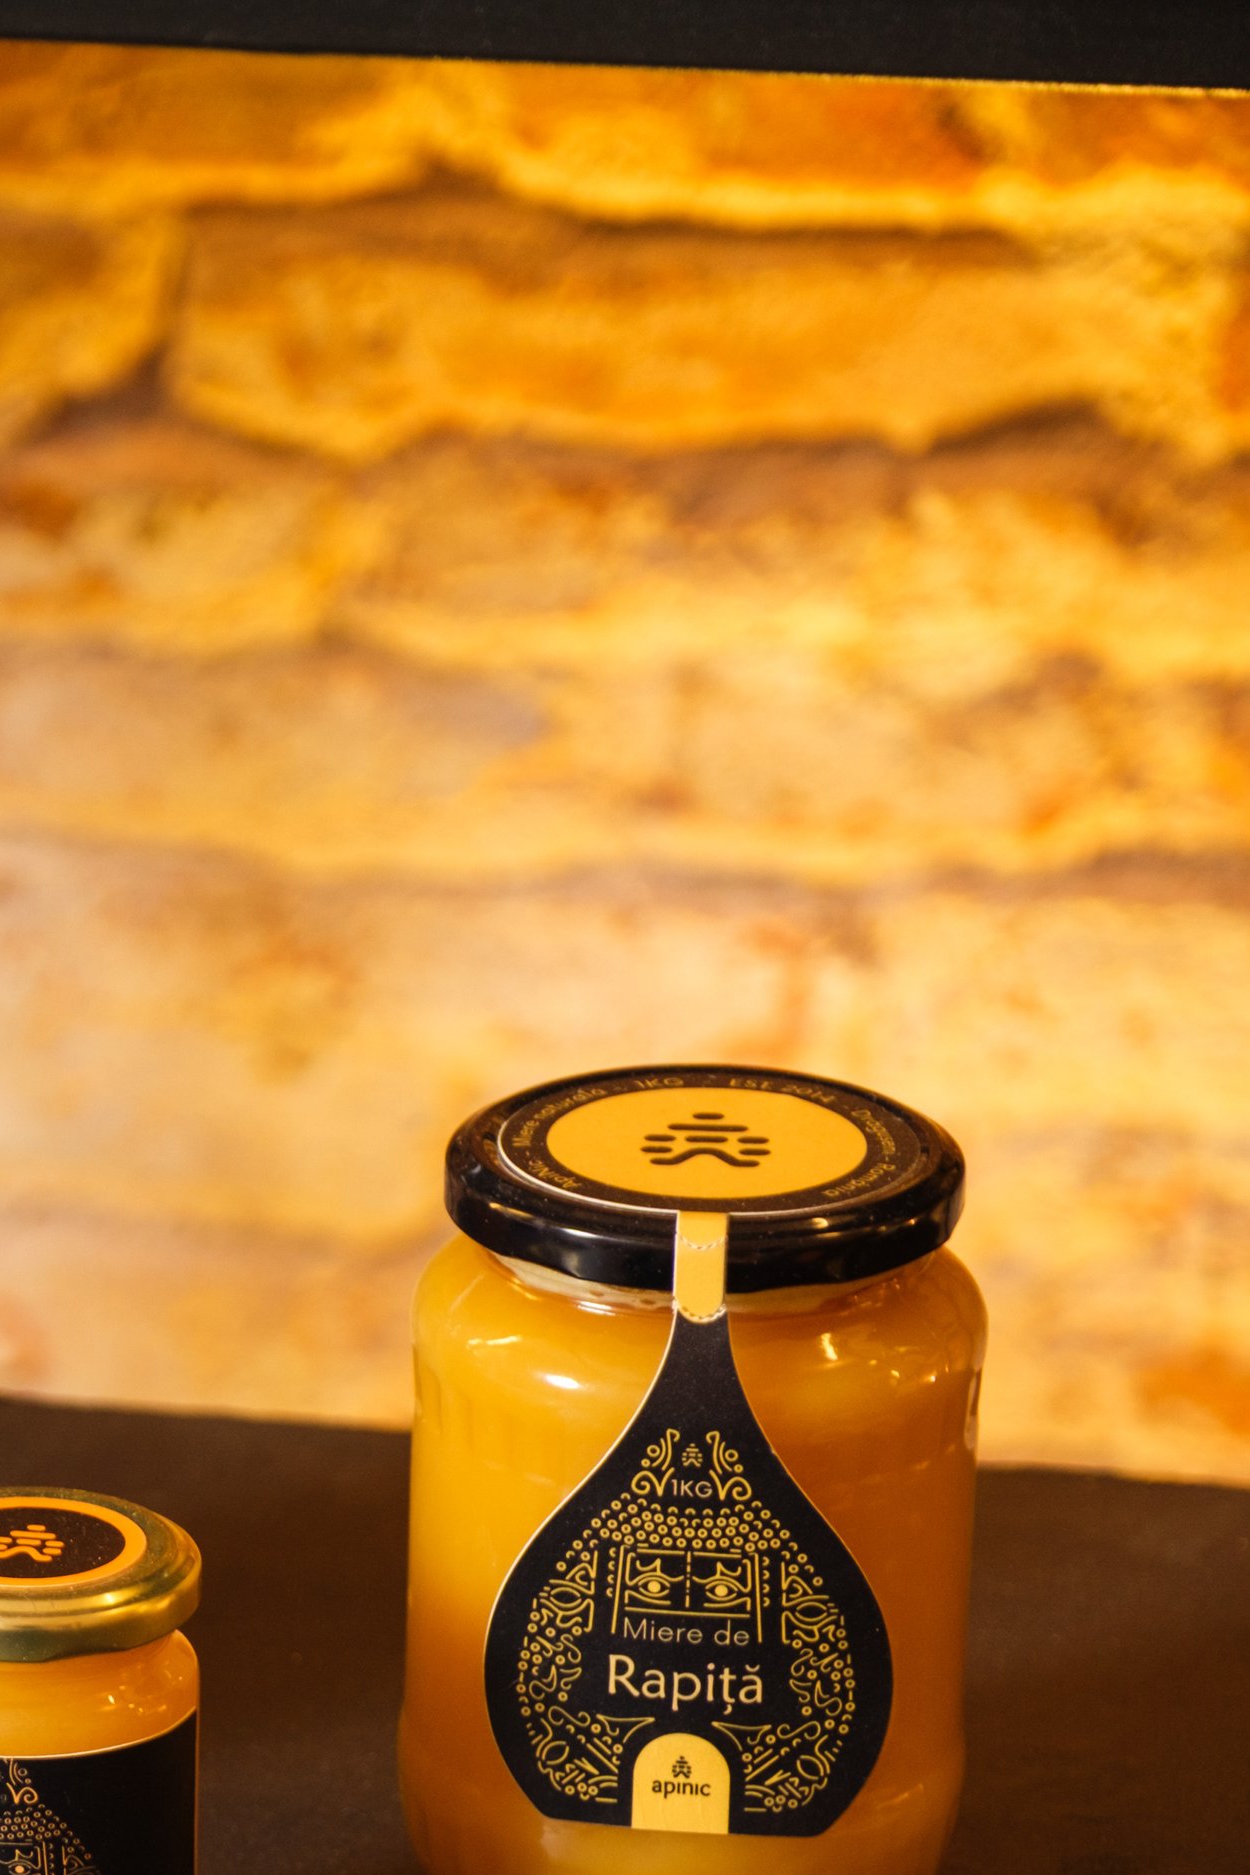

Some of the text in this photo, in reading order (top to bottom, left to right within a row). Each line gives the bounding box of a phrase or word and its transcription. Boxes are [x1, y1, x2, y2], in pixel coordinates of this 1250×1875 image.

[634, 1076, 685, 1089] 1KG
[670, 1478, 713, 1500] 1KG
[622, 1618, 751, 1648] Miere de
[606, 1653, 764, 1716] Rapiță
[650, 1777, 712, 1801] apinic
